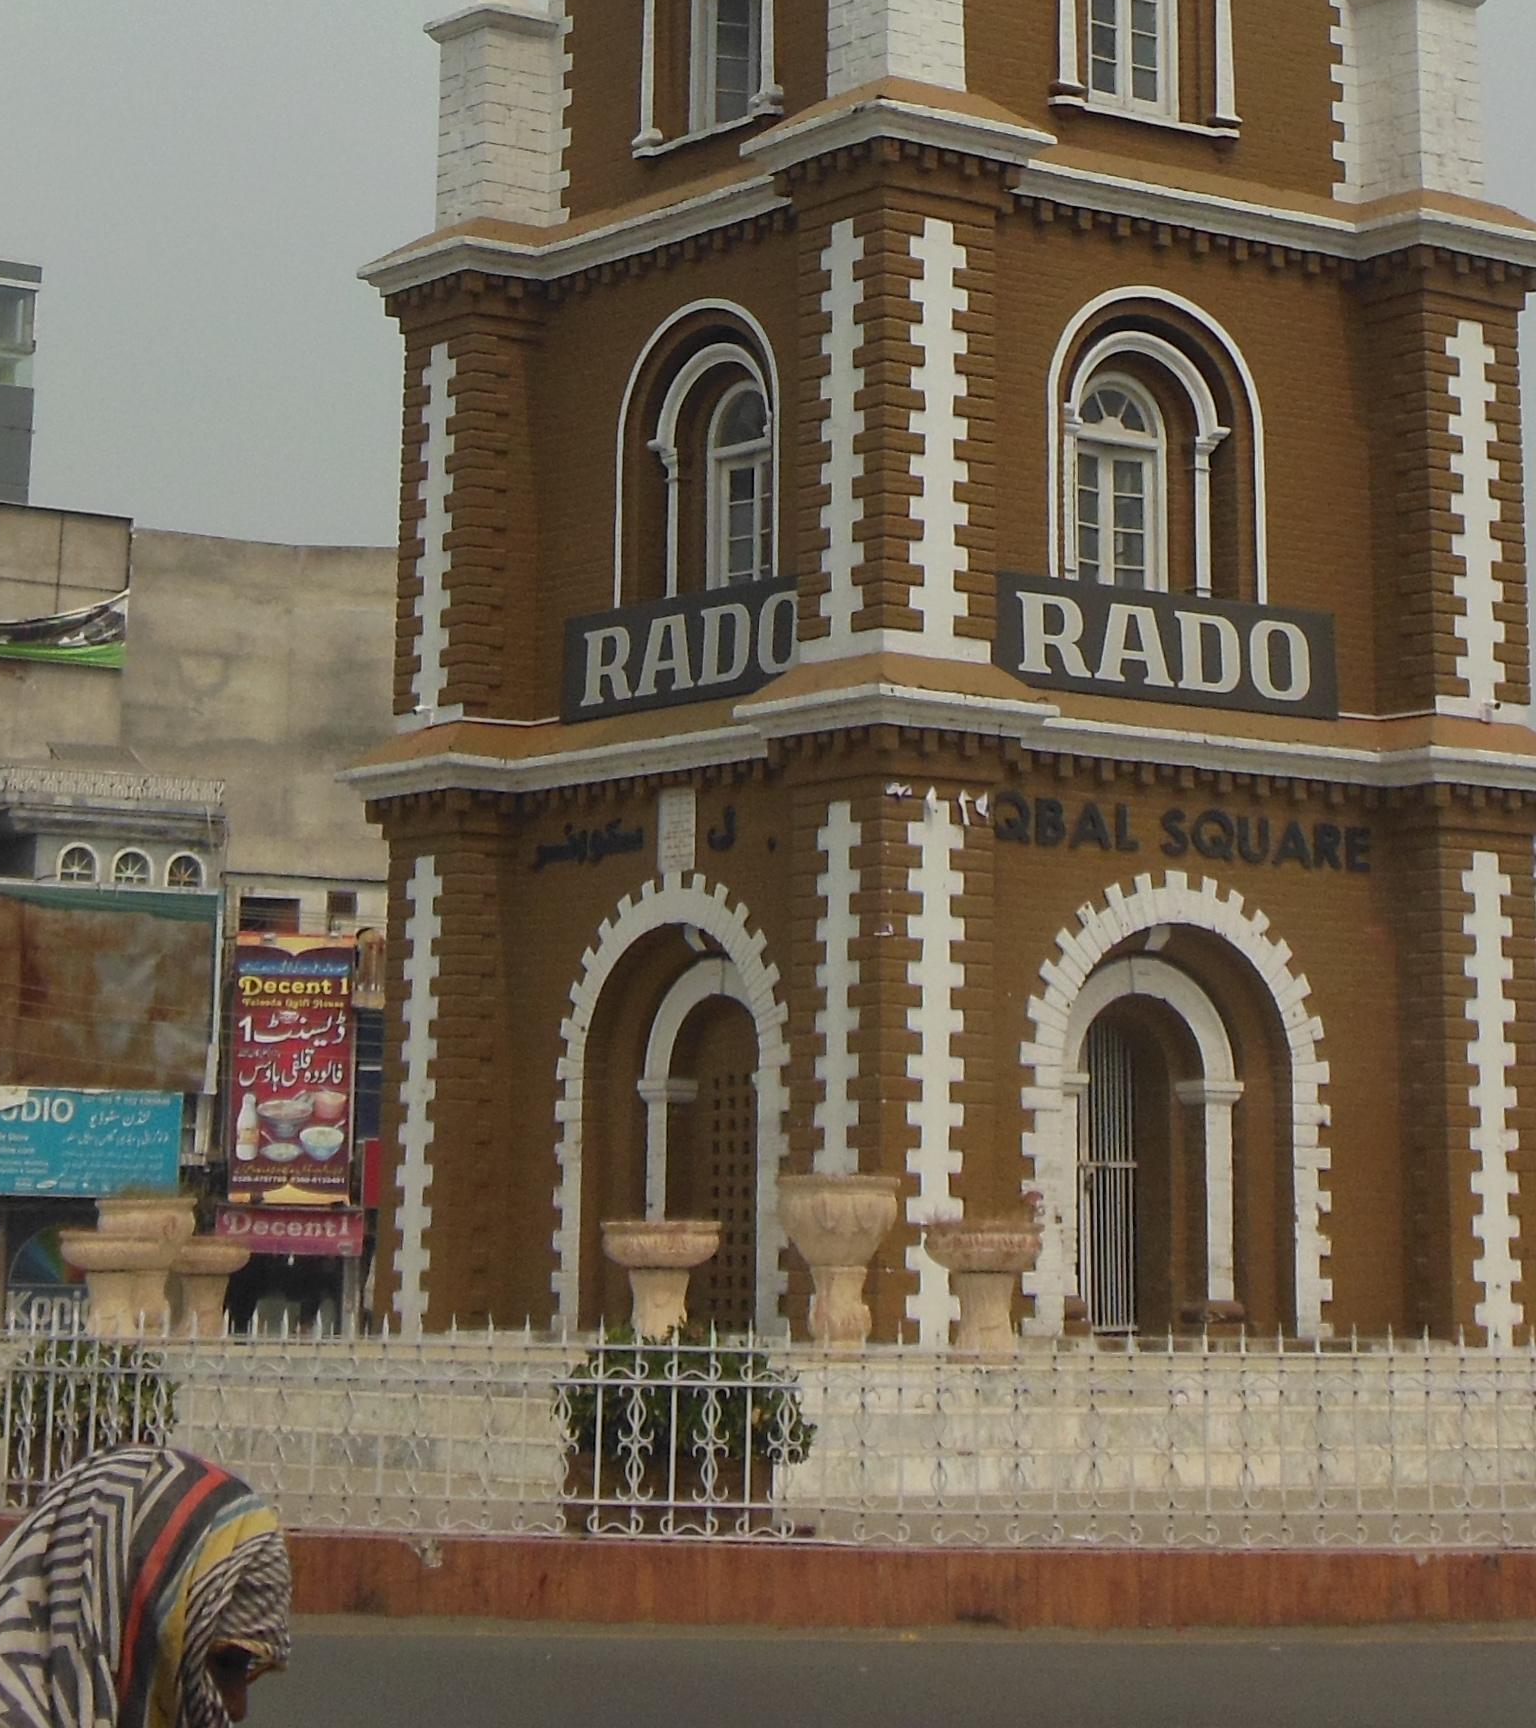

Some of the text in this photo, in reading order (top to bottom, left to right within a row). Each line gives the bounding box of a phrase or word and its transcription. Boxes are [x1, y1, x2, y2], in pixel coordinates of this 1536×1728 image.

[580, 590, 798, 707] RADO
[1015, 590, 1311, 702] RADO
[1158, 808, 1371, 872] SQUARE
[238, 975, 333, 996] Decent
[222, 1212, 337, 1238] Decent
[7, 1290, 91, 1335] Konic
